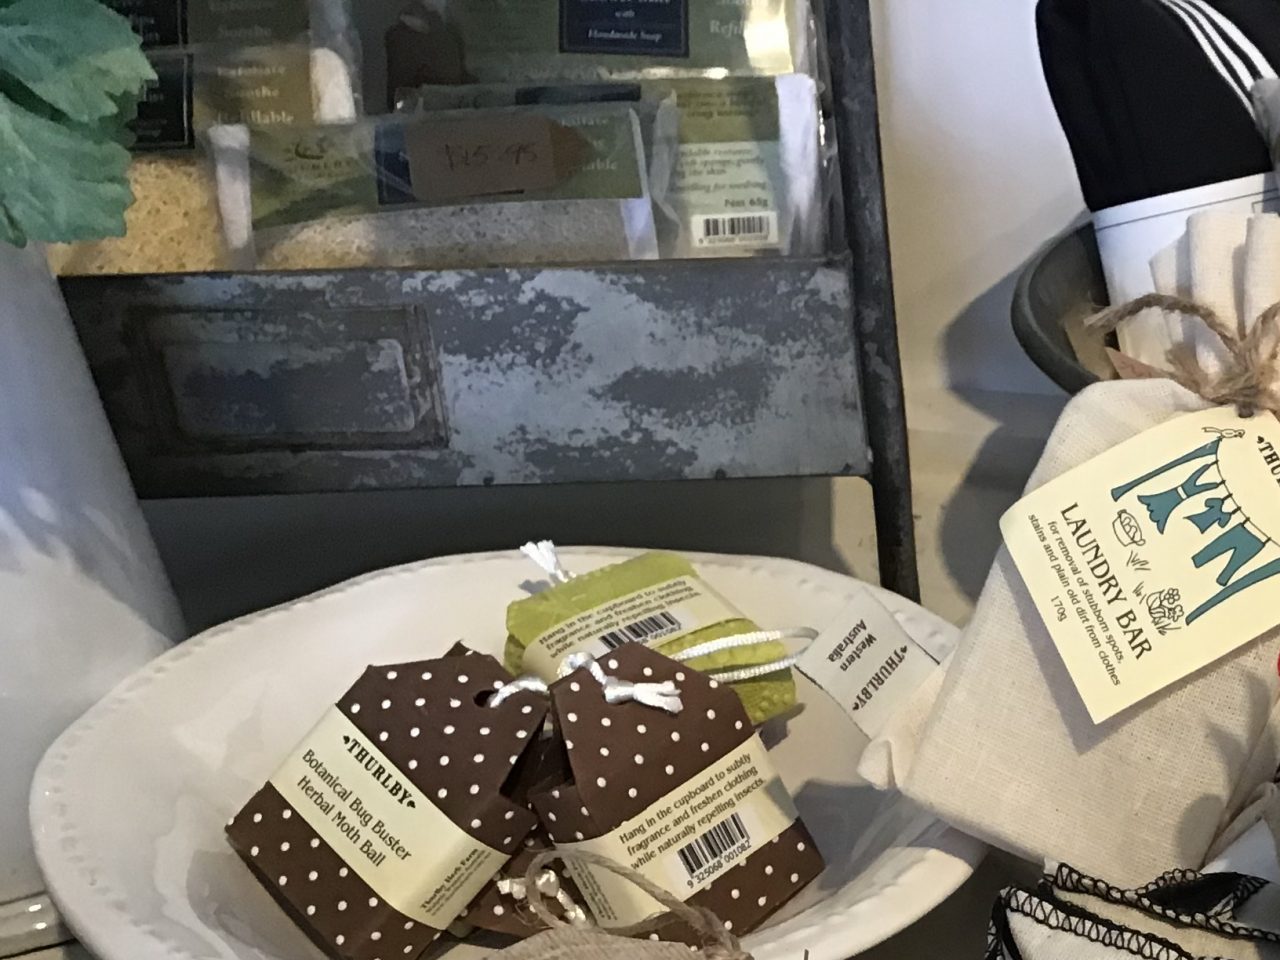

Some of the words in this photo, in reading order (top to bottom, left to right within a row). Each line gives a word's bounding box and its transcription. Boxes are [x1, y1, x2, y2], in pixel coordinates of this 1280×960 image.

[1047, 520, 1059, 535] for
[1054, 530, 1080, 577] removal
[1028, 512, 1048, 544] stains
[1042, 539, 1058, 563] and
[1052, 559, 1072, 592] plain
[1067, 588, 1079, 606] old
[1074, 603, 1090, 625] dirt
[1085, 621, 1102, 651] from
[1097, 648, 1122, 688] clothes
[1060, 501, 1129, 606] LAUNDRY
[1115, 605, 1154, 662] BAR
[1077, 574, 1088, 588] of
[538, 625, 566, 646] Hang
[566, 620, 576, 630] in
[595, 613, 614, 627] and
[1050, 594, 1067, 624] 170g
[1082, 585, 1112, 637] stubborn
[550, 641, 575, 660] while
[828, 619, 868, 663] Australia
[840, 632, 877, 672] Western
[1106, 633, 1125, 666] spots,
[857, 648, 905, 709] THURLBY
[347, 738, 413, 808] THURLBY
[297, 775, 333, 816] Herbal
[331, 812, 361, 845] Moth
[359, 840, 387, 868] Ball
[302, 748, 349, 802] Botanical
[349, 797, 375, 828] Bug
[371, 820, 413, 861] Buster
[618, 822, 645, 845] Hang
[645, 817, 658, 831] in
[657, 809, 673, 826] the
[672, 778, 716, 816] cupboard
[715, 770, 727, 786] to
[725, 753, 752, 779] subtly
[626, 825, 673, 857] fragrance
[673, 812, 690, 830] and
[689, 791, 726, 820] freshen
[724, 765, 759, 799] clothing
[630, 850, 658, 872] while
[657, 825, 698, 858] naturally
[696, 800, 737, 835] repelling
[686, 880, 695, 890] 9
[723, 839, 754, 866] 001082
